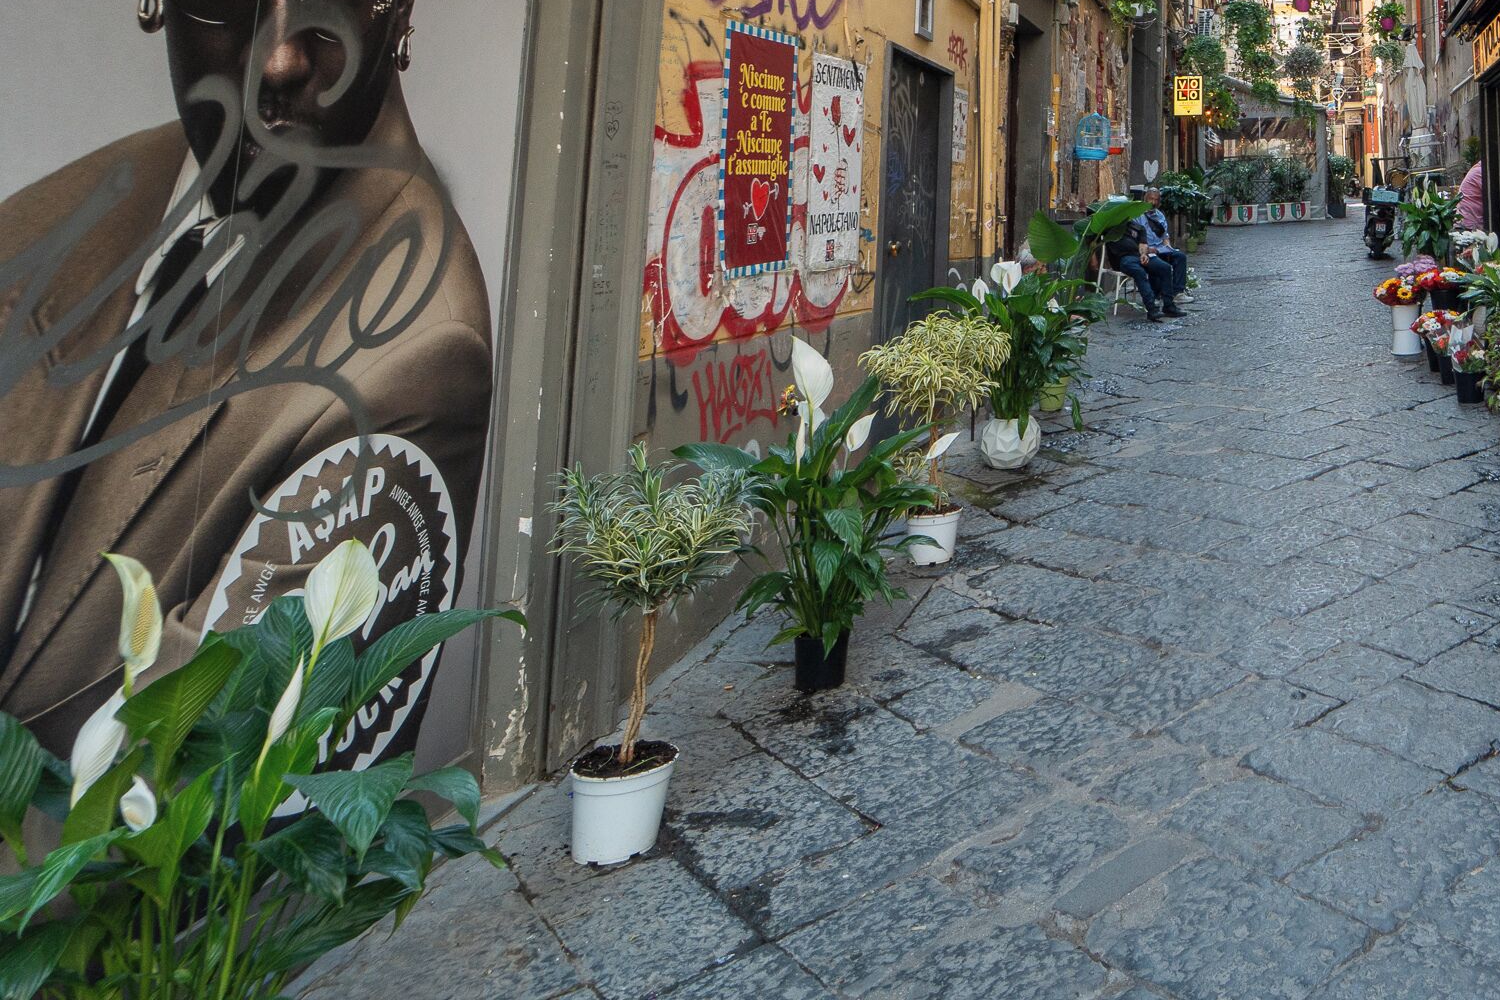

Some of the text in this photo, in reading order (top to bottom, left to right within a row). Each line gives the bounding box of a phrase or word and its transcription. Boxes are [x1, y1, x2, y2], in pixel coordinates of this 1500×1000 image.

[739, 63, 785, 92] Nisciune
[750, 92, 786, 113] comme
[750, 110, 773, 132] a Te
[736, 129, 782, 157] Nisciune
[809, 211, 859, 236] NAPOLETANO
[287, 466, 386, 564] A$AP
[389, 484, 413, 510] AWGE
[406, 501, 426, 532] AWGE
[250, 560, 278, 603] AWGE
